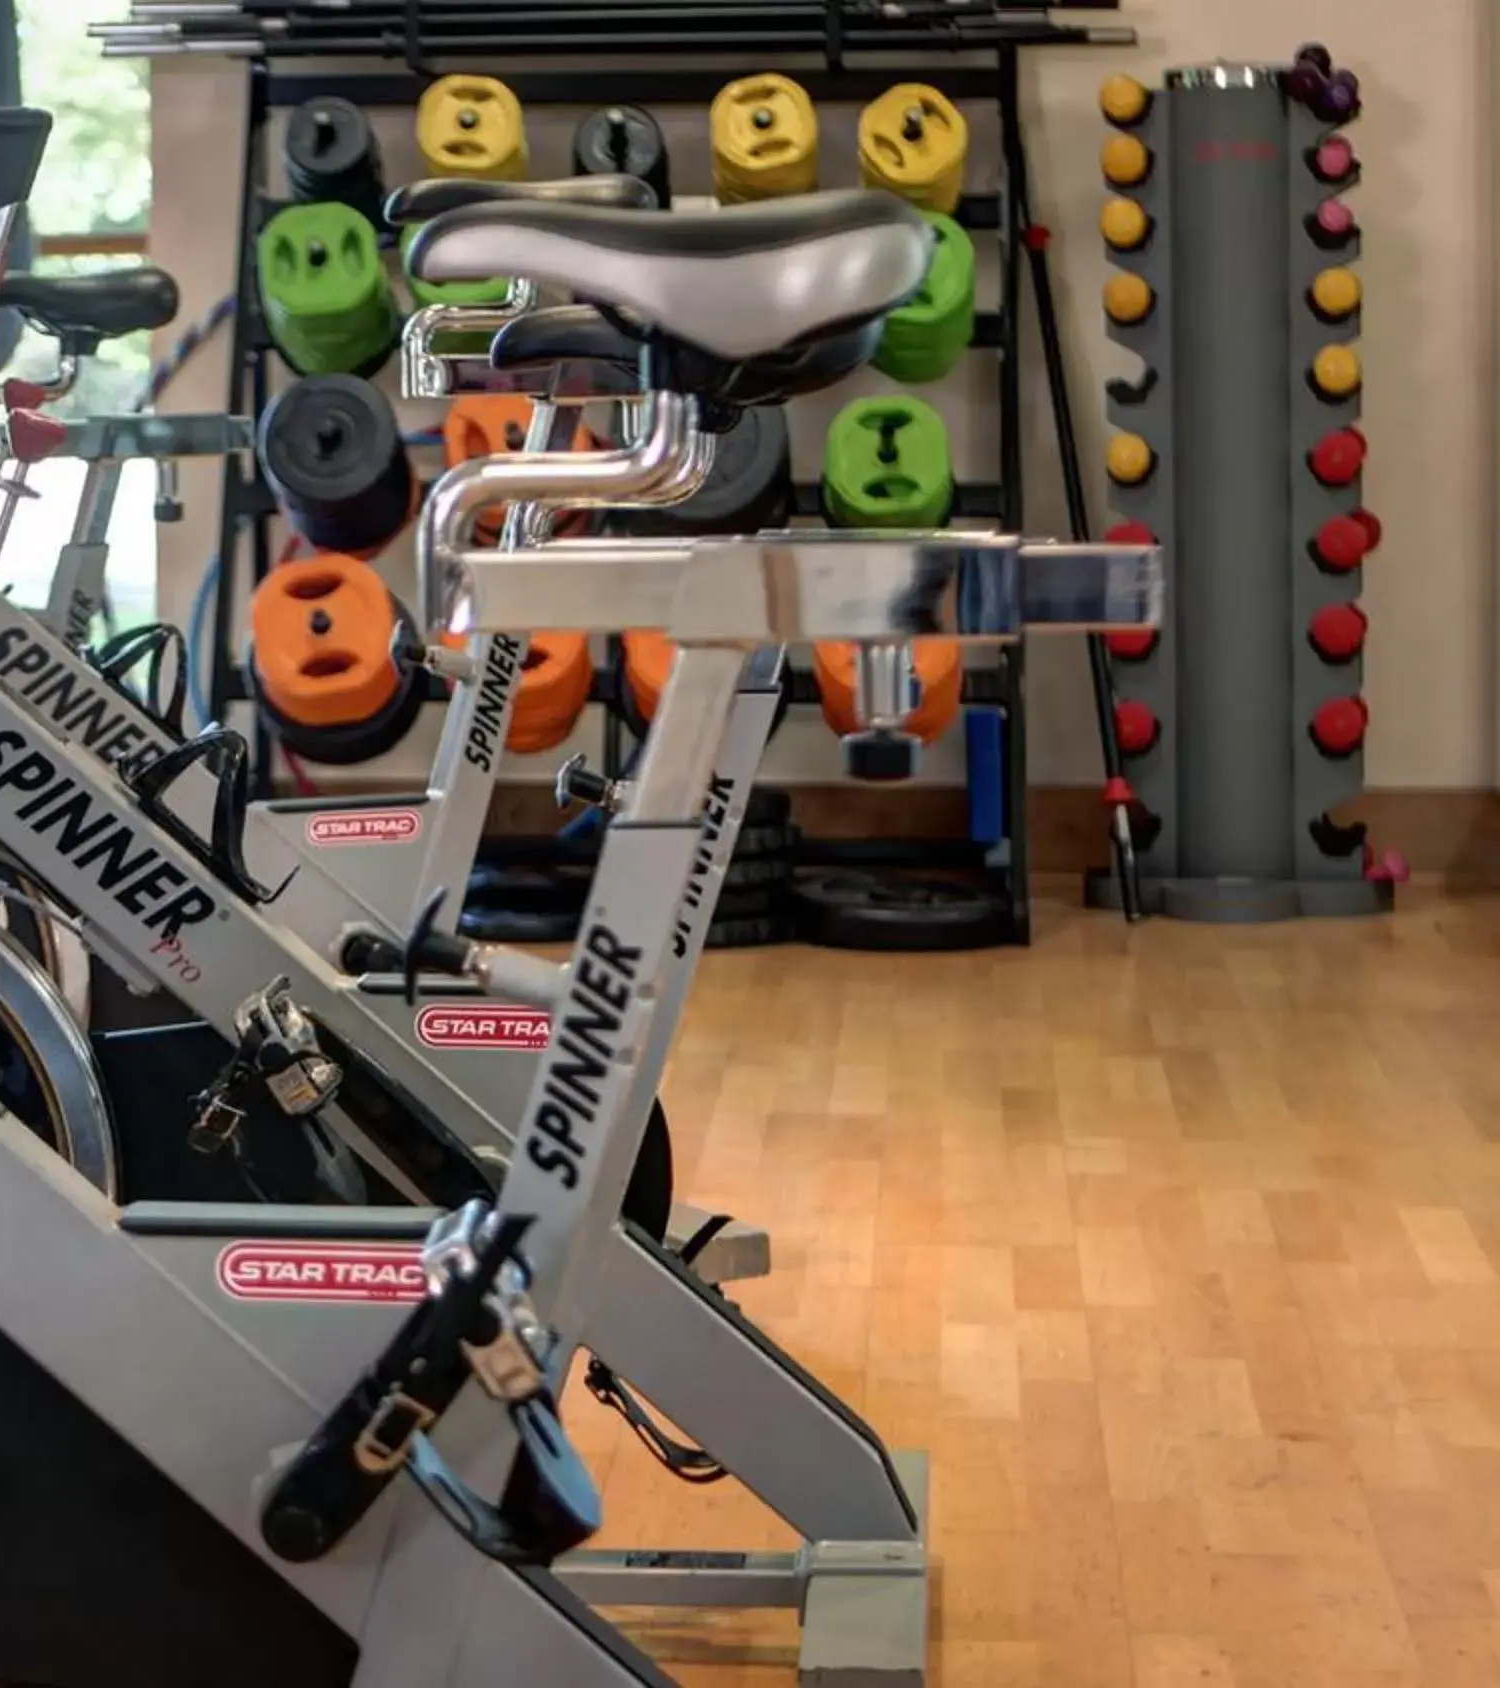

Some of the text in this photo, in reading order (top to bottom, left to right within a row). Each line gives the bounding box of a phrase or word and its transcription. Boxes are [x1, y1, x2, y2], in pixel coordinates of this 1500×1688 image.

[464, 631, 521, 773] SPINNER
[316, 818, 413, 835] STAR TRAC
[149, 931, 202, 984] Pro
[431, 1018, 550, 1037] STAR TRA
[526, 923, 644, 1190] SPINNER
[238, 1259, 424, 1285] STAR TRAC
